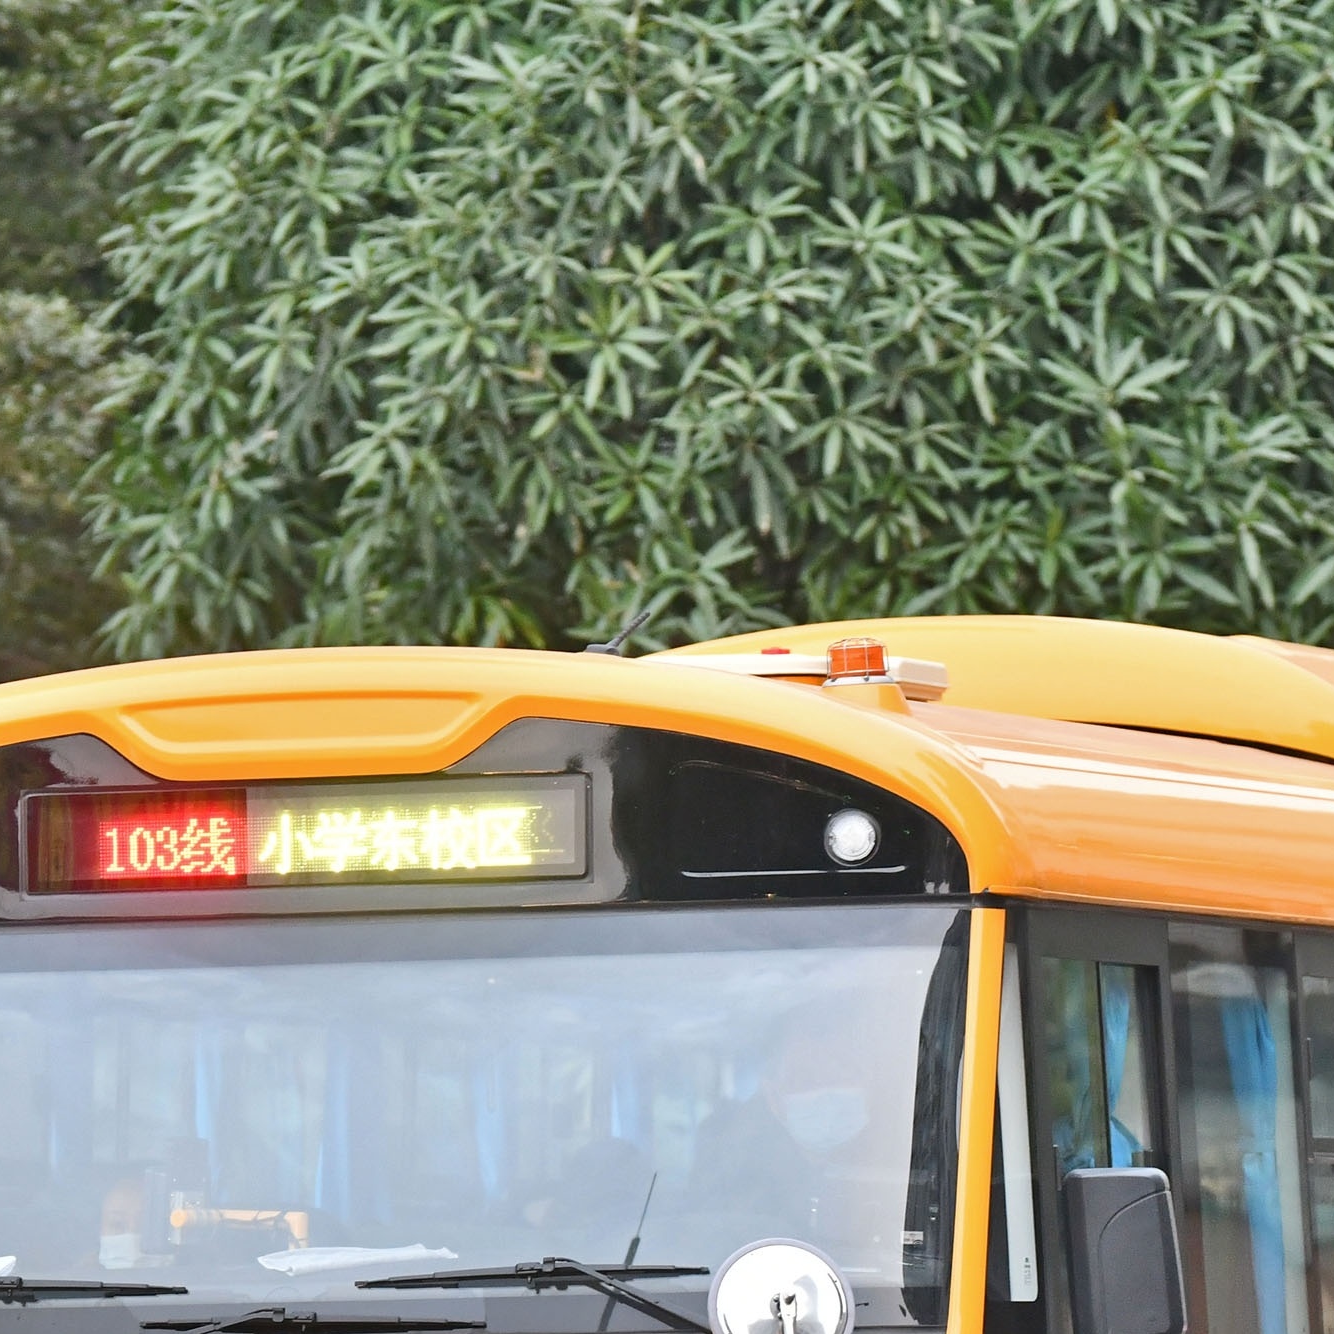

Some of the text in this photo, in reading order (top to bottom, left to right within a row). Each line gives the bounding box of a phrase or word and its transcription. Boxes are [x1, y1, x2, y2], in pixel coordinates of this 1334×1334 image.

[104, 804, 533, 876] 103线 小学东校区
